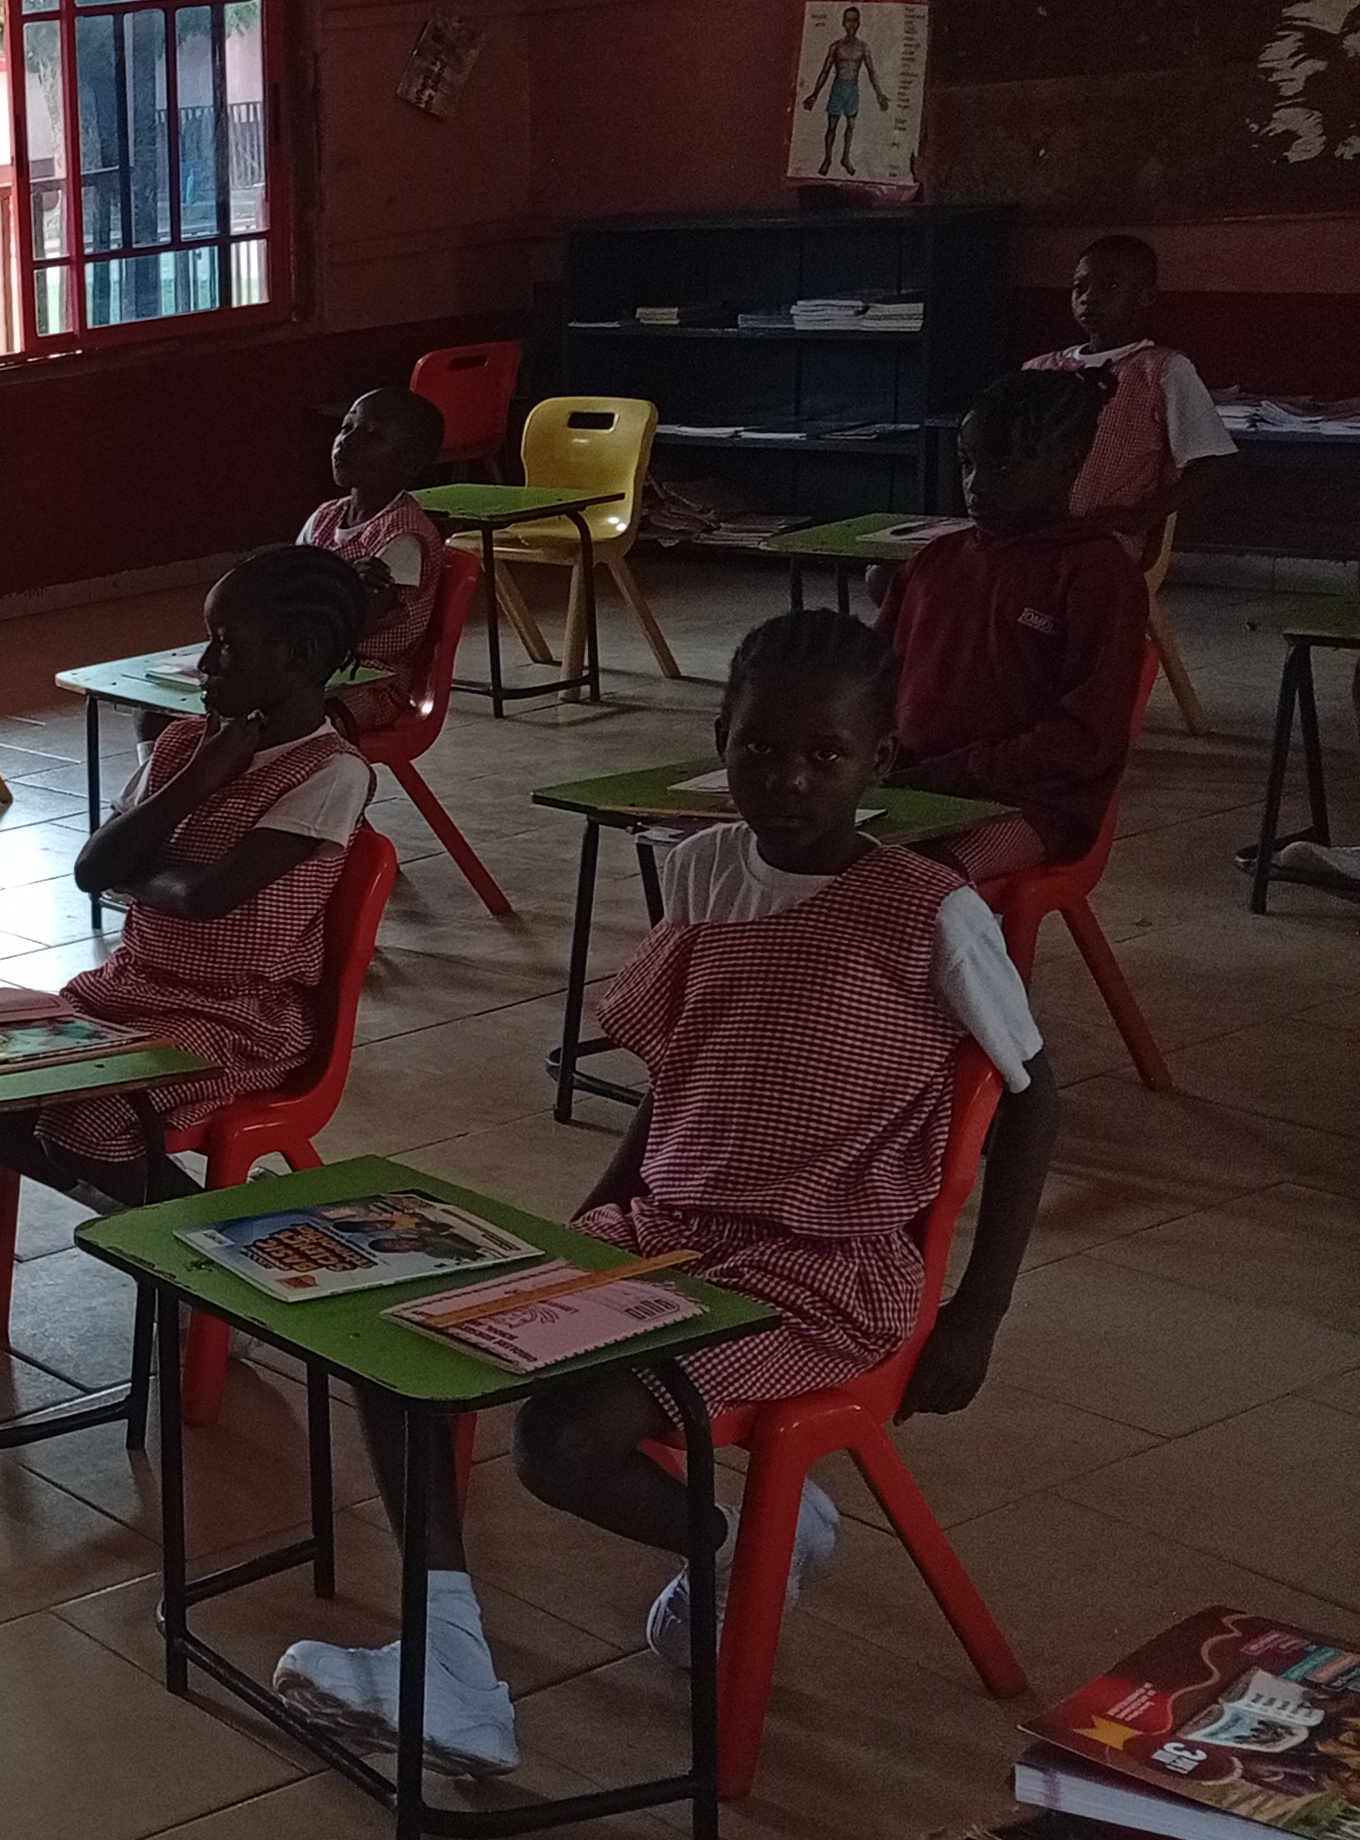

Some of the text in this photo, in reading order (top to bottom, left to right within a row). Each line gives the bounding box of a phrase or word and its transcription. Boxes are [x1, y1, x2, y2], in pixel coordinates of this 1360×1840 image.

[255, 1239, 318, 1271] BASIC
[273, 1230, 352, 1271] SCIENCE
[1163, 1742, 1208, 1761] 3
